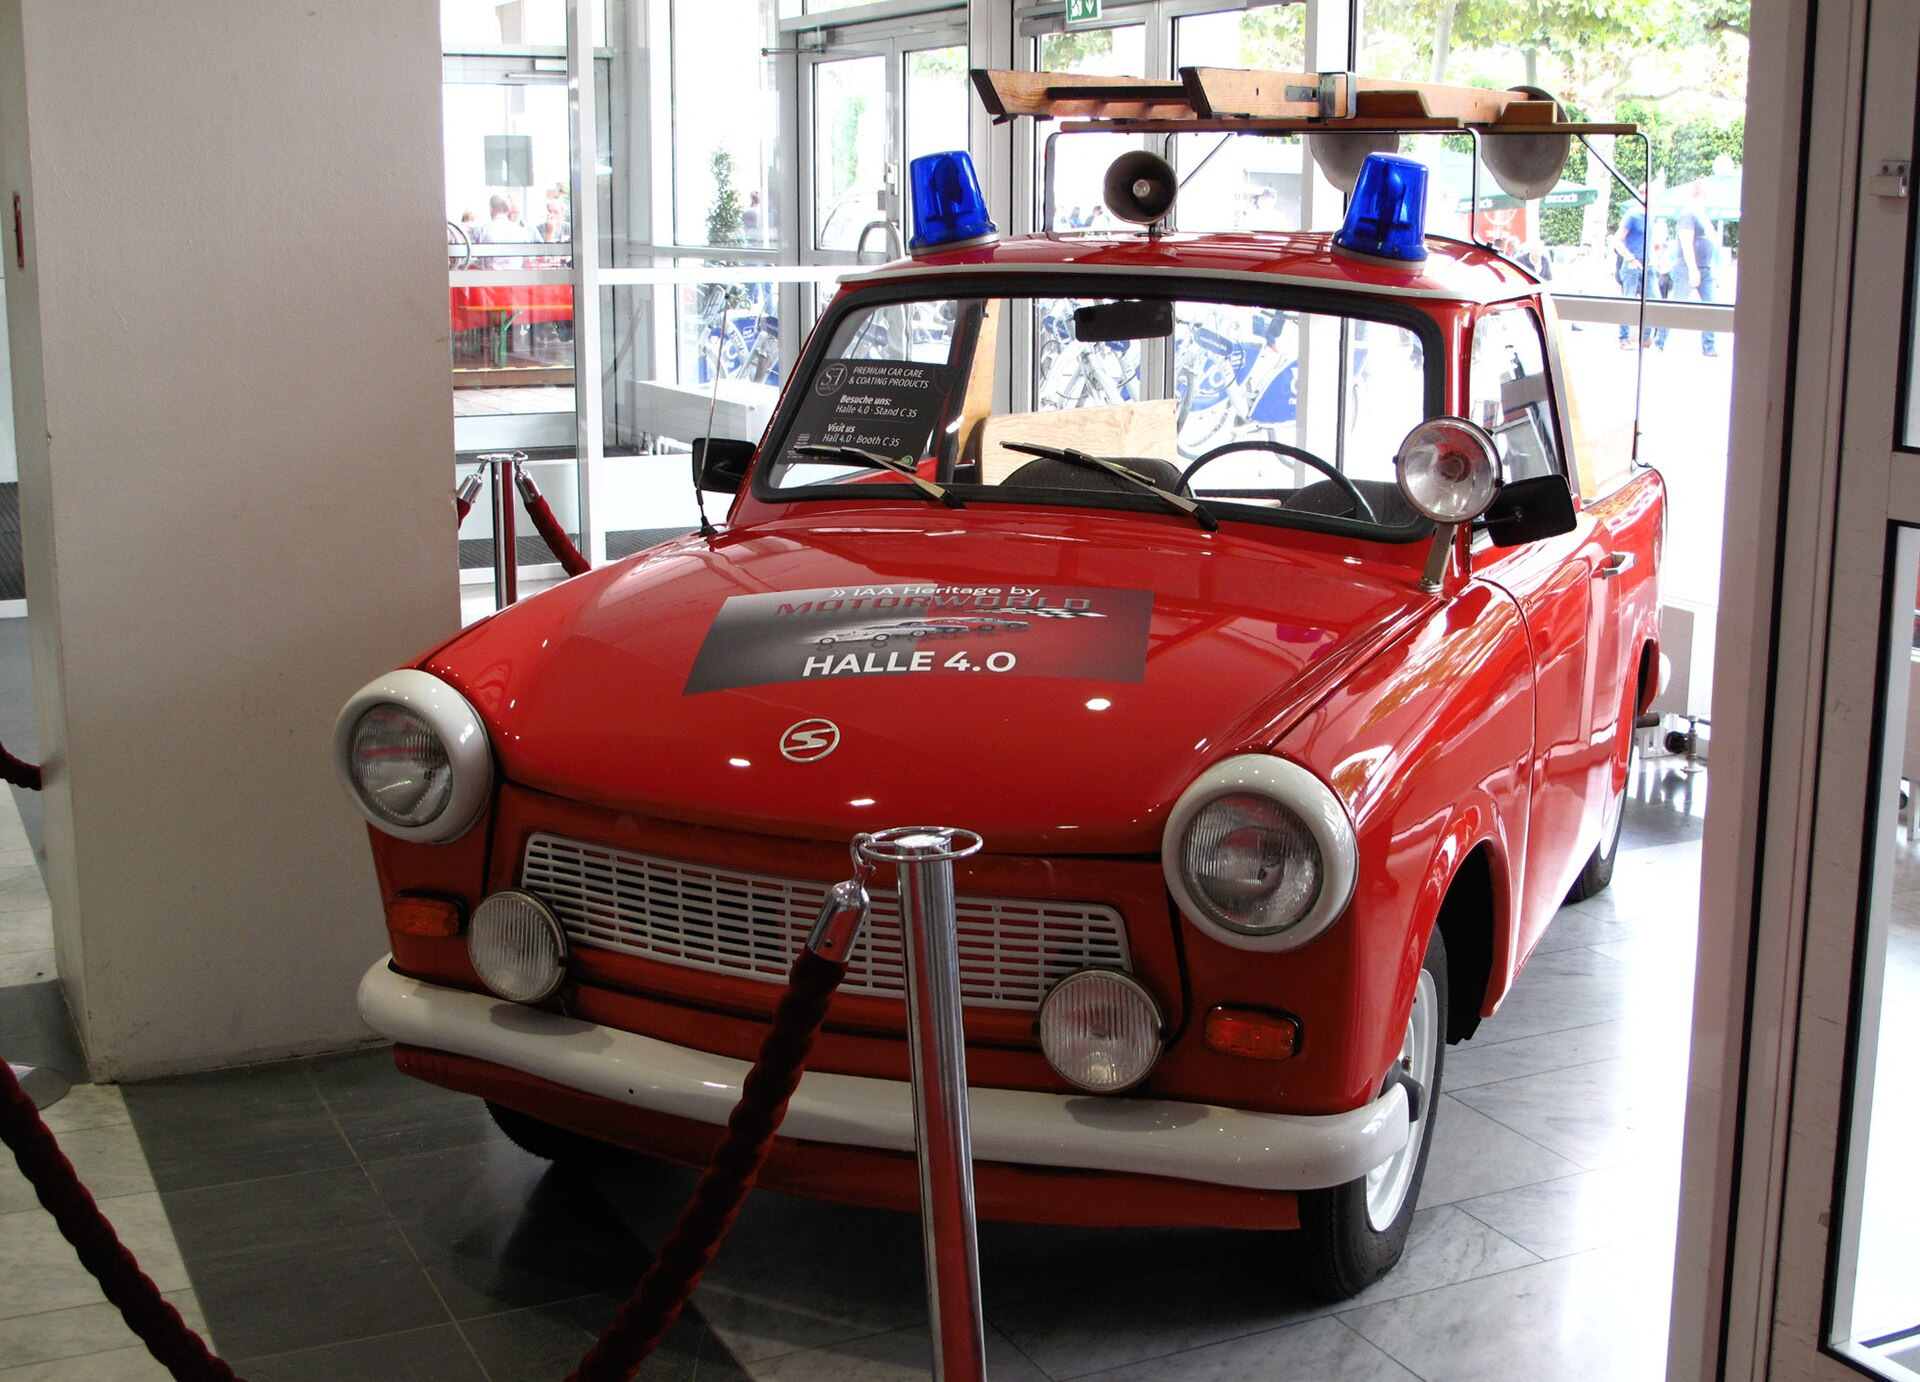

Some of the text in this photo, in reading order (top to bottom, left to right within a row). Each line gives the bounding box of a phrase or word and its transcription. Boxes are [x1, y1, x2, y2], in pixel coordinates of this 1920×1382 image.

[853, 366, 924, 378] PREMIUM CAR CARE
[848, 376, 929, 389] & COATING PRODUCTS
[840, 395, 892, 405] Besuche uns:
[835, 404, 917, 418] Halle 4.0 Stand C 35
[827, 422, 856, 433] Visit us
[823, 433, 900, 446] Hall 4.0 Booth C 35
[853, 585, 1041, 598] IAA Heritage by
[775, 595, 1092, 615] MOTORWORLD
[802, 650, 933, 677] HALLE
